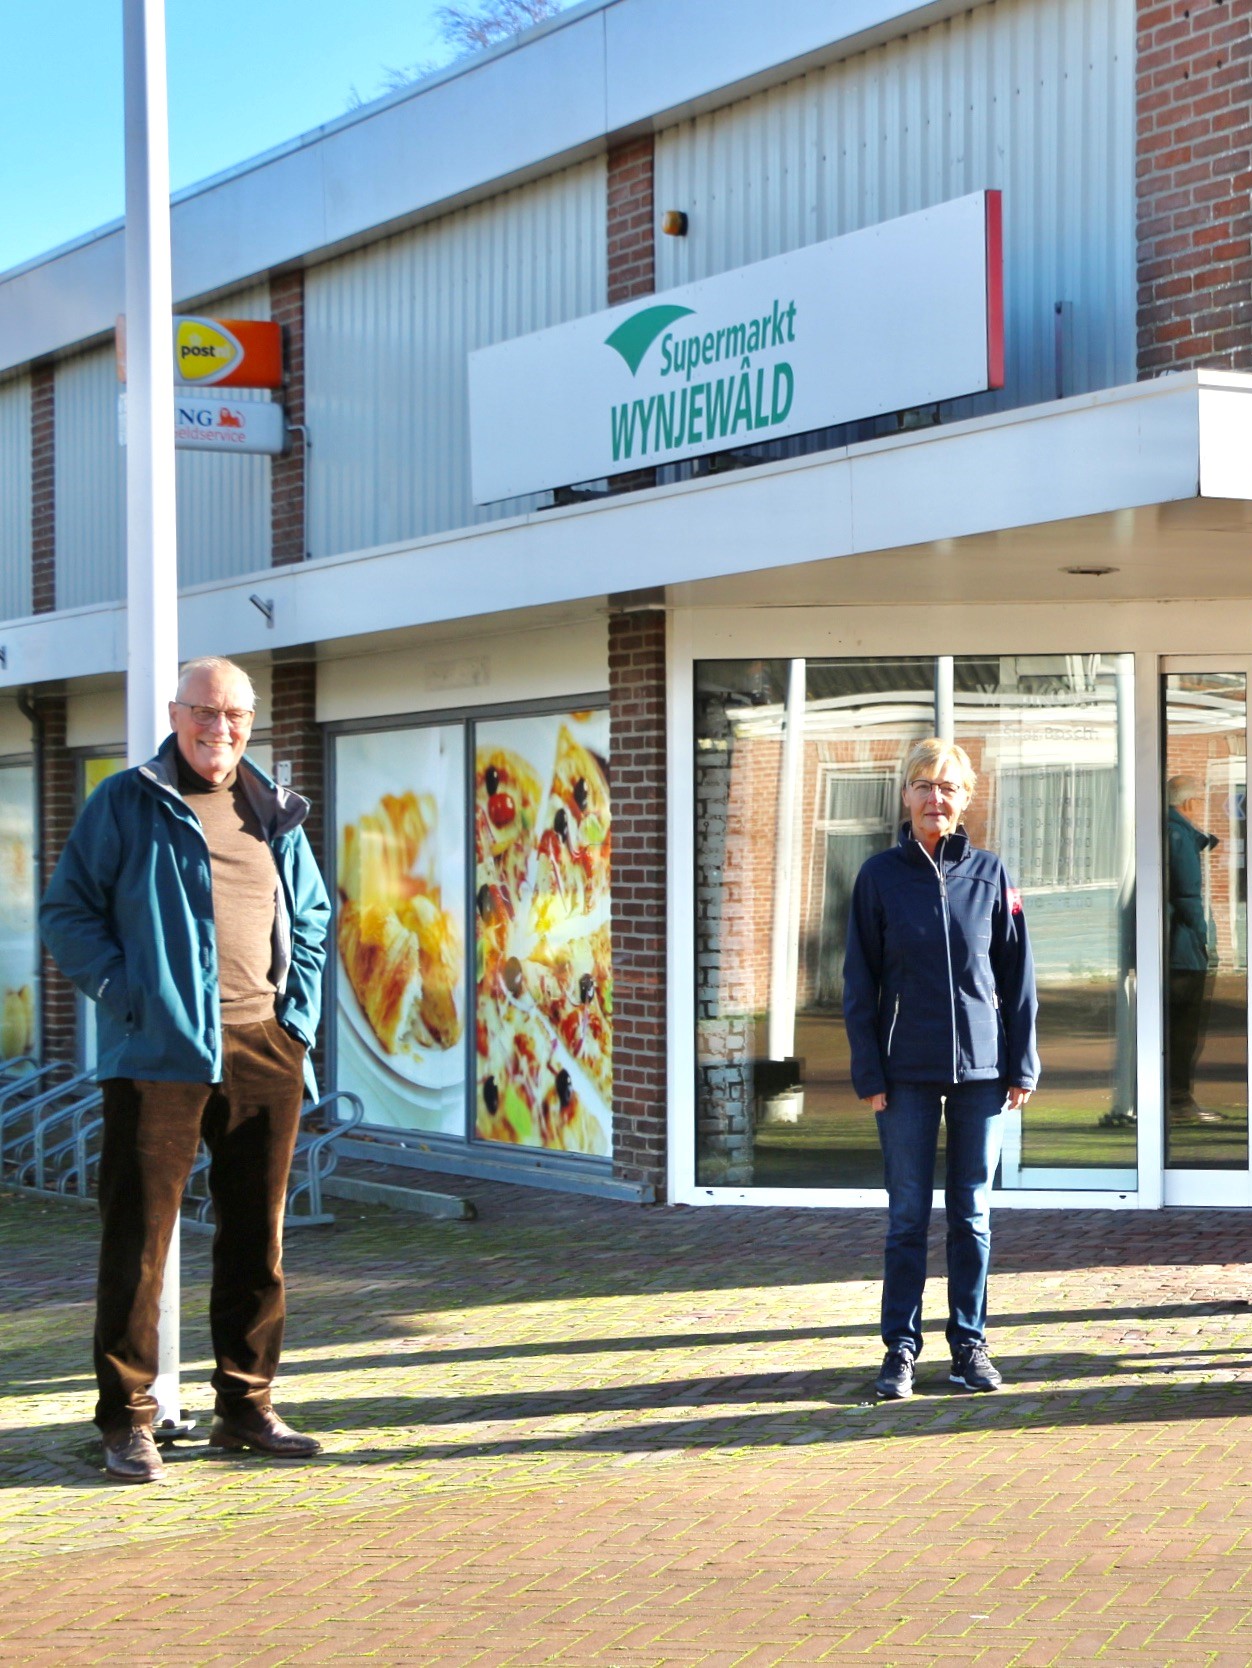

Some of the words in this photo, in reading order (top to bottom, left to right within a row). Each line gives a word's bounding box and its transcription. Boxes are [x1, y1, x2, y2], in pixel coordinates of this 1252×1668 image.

[660, 299, 797, 382] Supermarkt
[179, 407, 212, 427] NG
[611, 357, 794, 462] WYNJEWÂLD
[174, 428, 246, 443] eldservice
